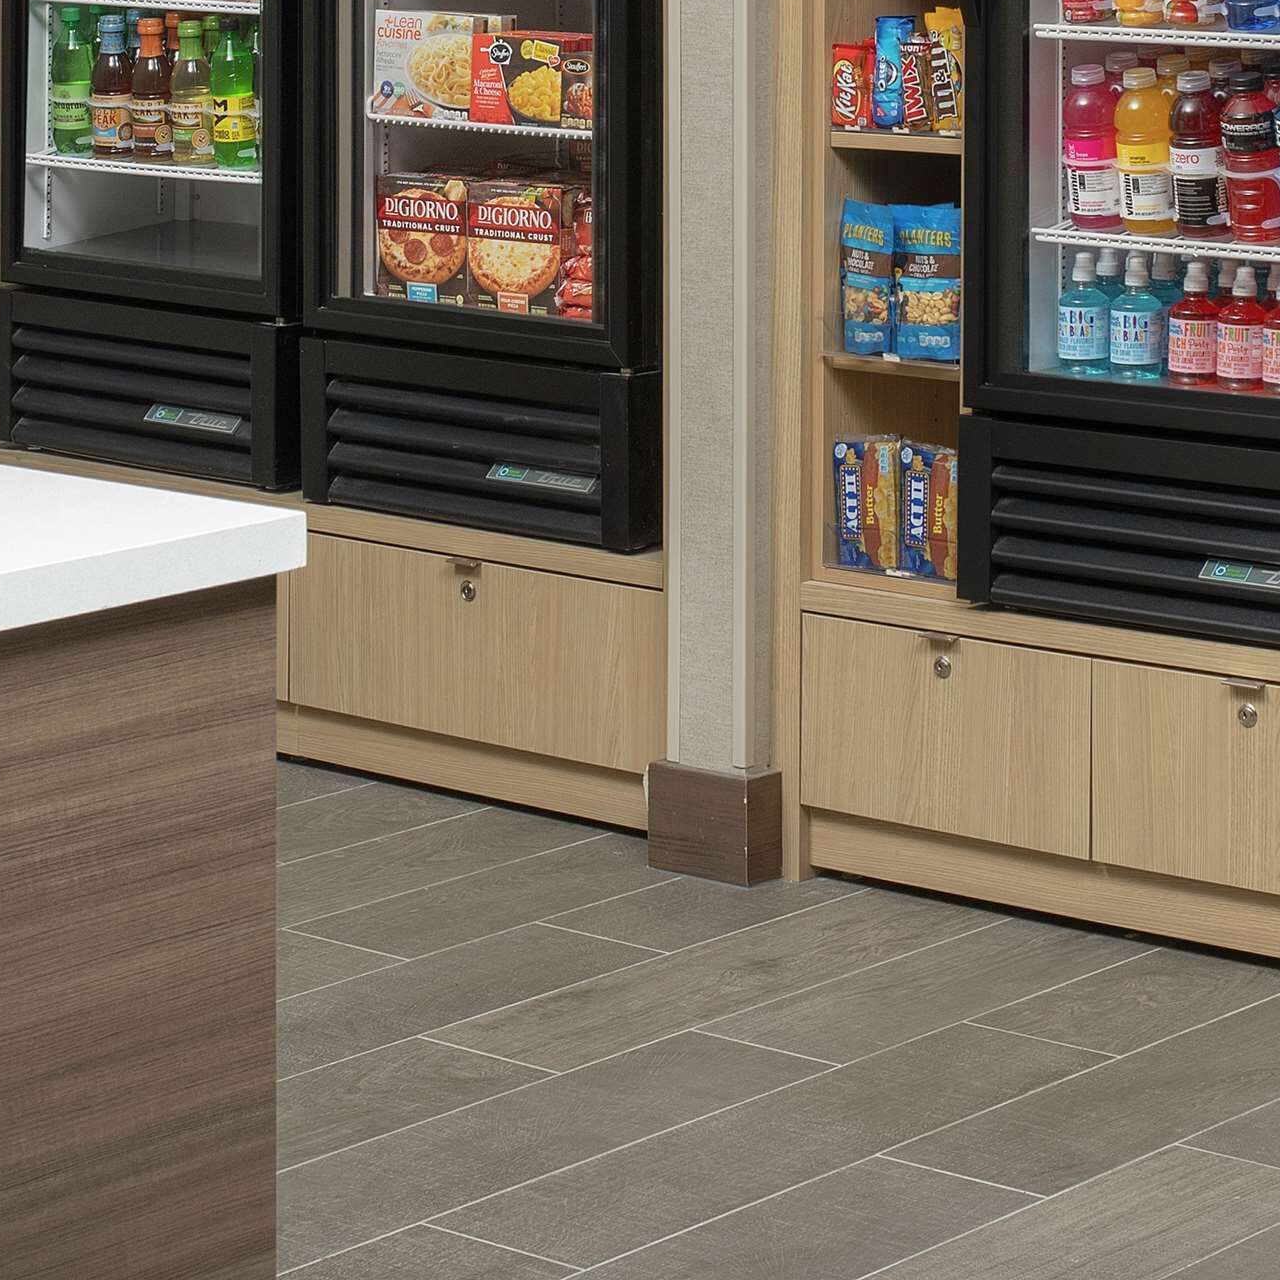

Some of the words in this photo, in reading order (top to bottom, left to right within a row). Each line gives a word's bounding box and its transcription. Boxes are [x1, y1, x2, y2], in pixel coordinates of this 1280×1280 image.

[1174, 153, 1200, 165] zero
[1071, 169, 1080, 212] vitamin
[1123, 173, 1134, 216] vitamin
[382, 219, 433, 231] TRADITIONAL
[434, 223, 461, 233] CRUST
[474, 228, 526, 240] TRADITIONAL
[528, 232, 554, 242] CRUST
[1070, 310, 1094, 325] BIG
[1123, 315, 1148, 329] BIG
[1184, 322, 1211, 337] FRUIT
[1224, 327, 1250, 339] FRUIT
[866, 485, 875, 525] Butter
[932, 493, 944, 534] Butter
